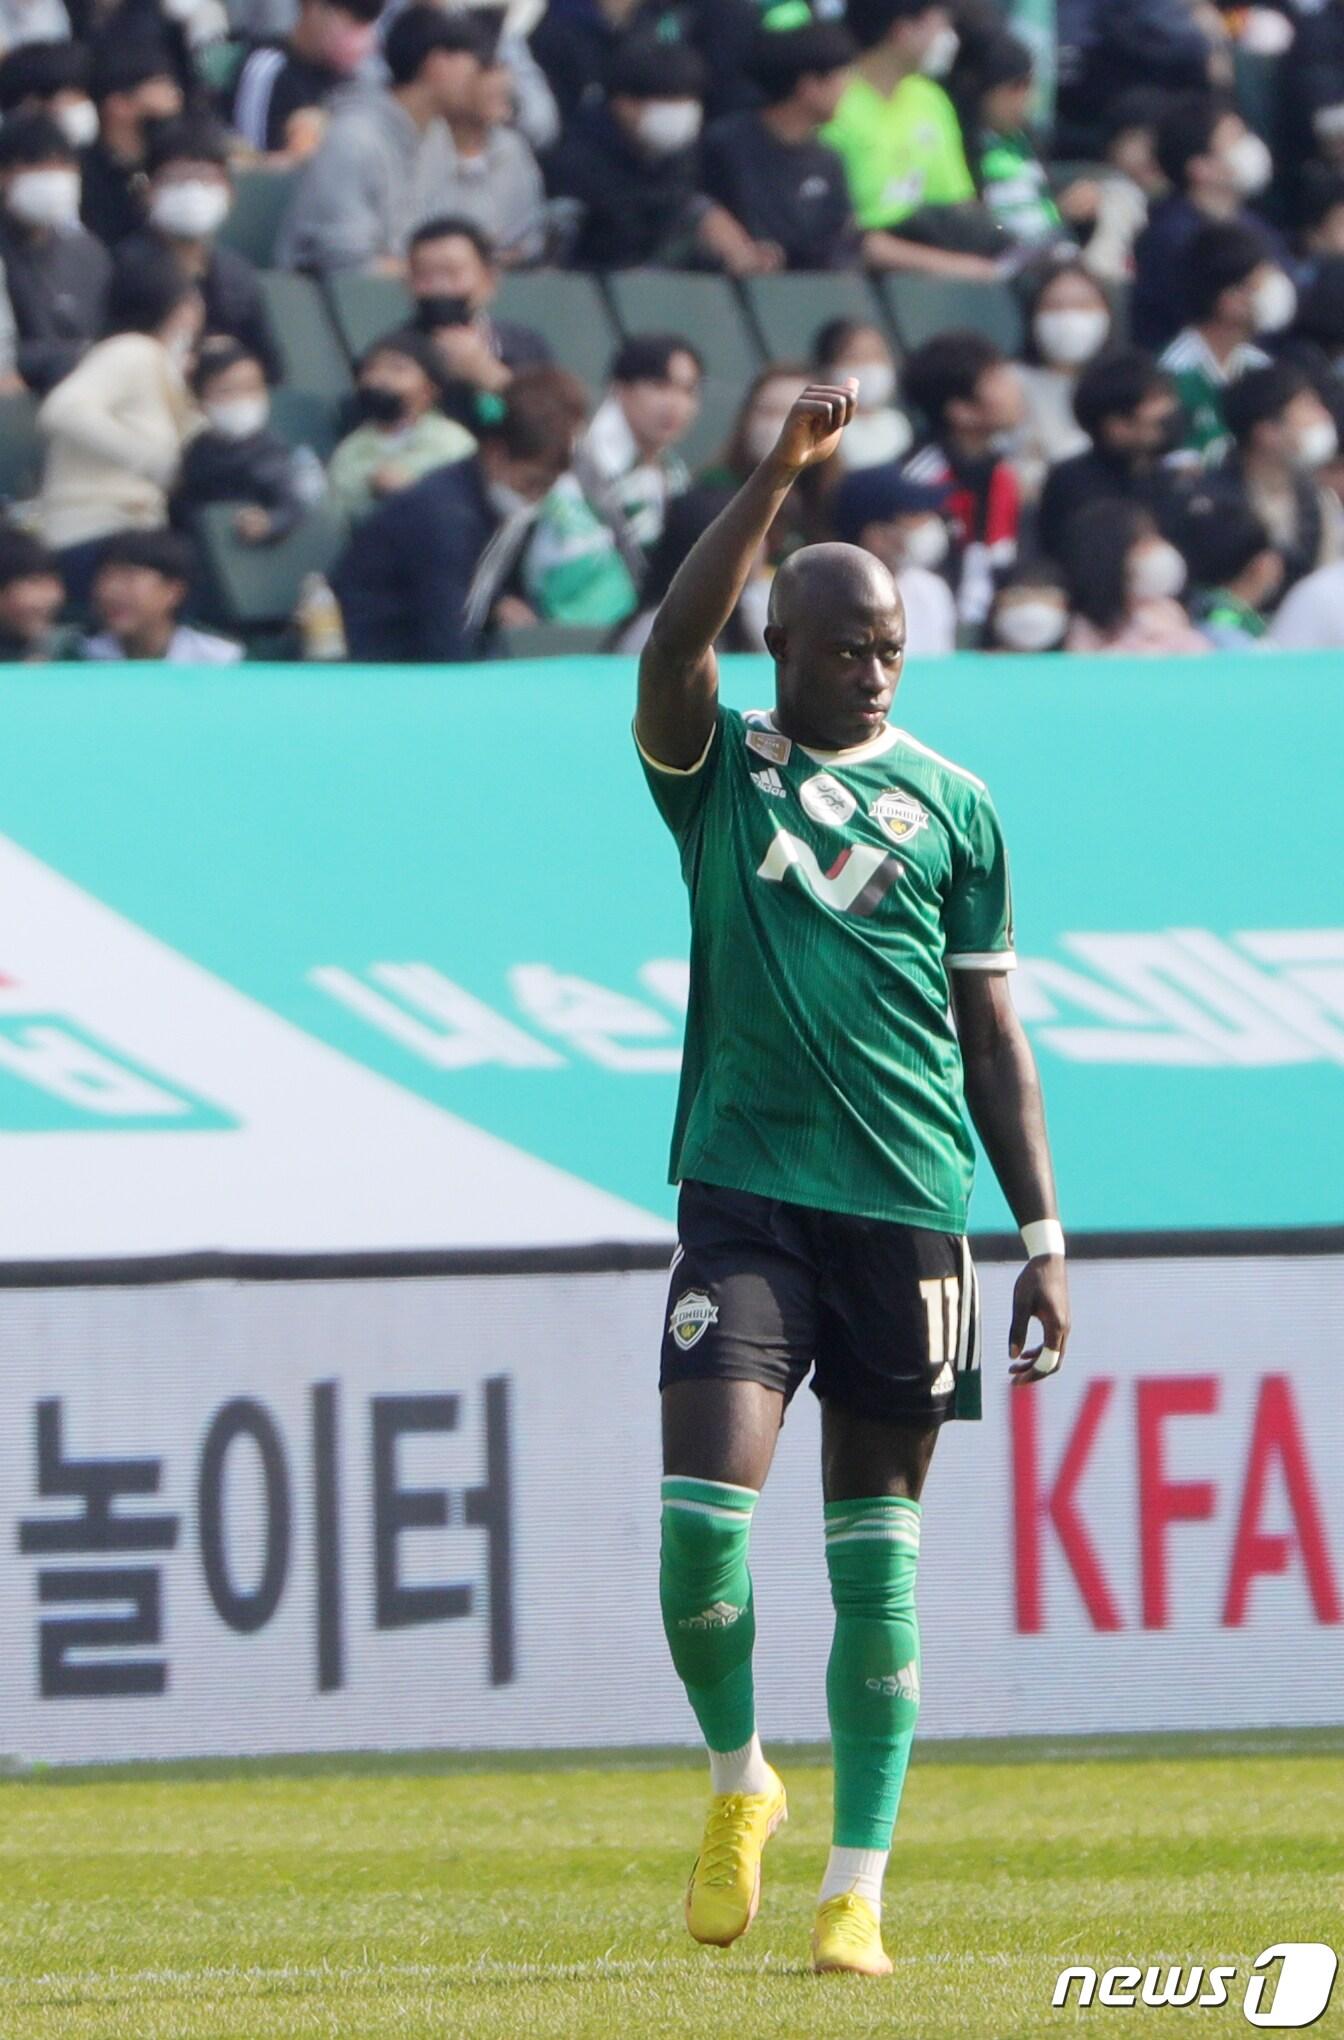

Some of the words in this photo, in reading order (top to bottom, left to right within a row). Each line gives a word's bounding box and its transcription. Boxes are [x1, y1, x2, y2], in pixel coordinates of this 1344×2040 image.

[918, 1276, 959, 1364] 11
[18, 1372, 517, 1700] 놀이터
[1009, 1371, 1344, 1636] KFA
